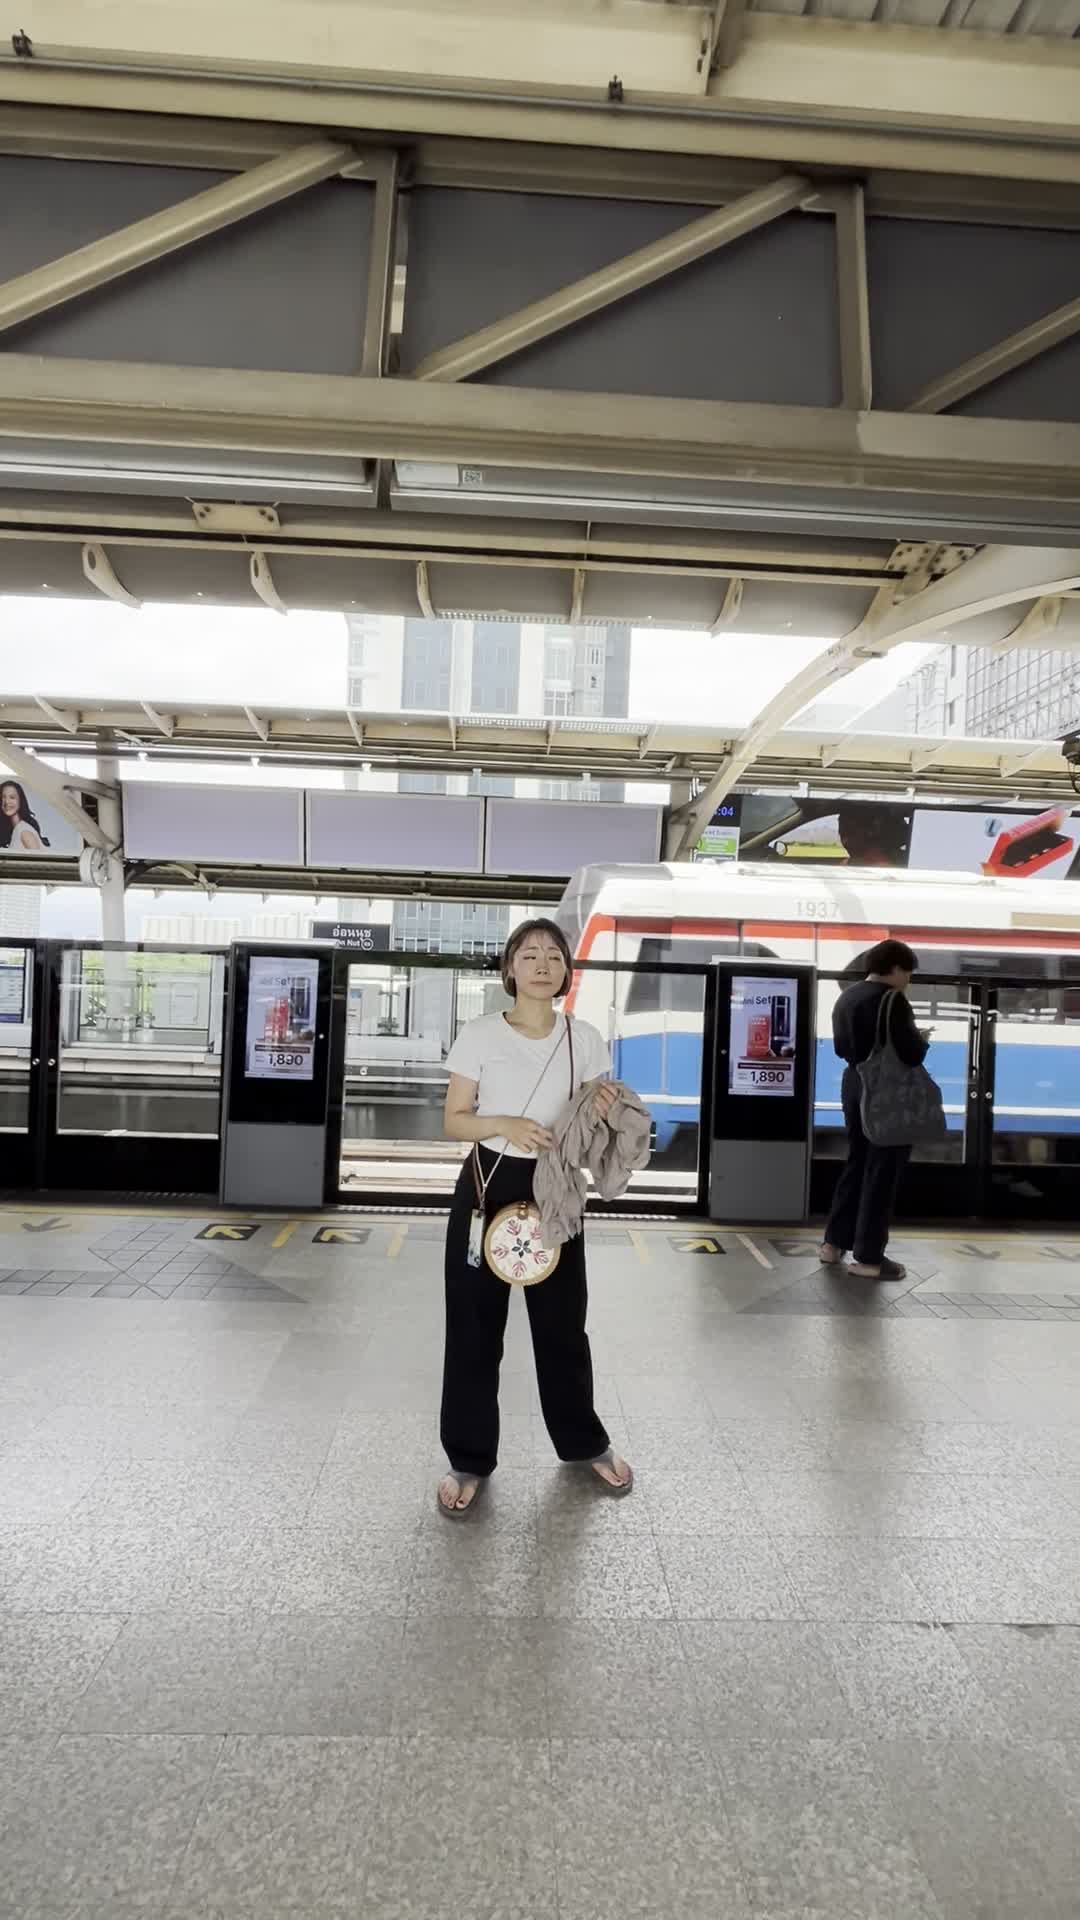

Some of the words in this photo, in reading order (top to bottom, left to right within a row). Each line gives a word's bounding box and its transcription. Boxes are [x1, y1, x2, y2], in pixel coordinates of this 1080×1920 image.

[796, 901, 840, 917] 1937
[756, 996, 772, 1005] Set
[750, 1071, 785, 1084] 1,890
